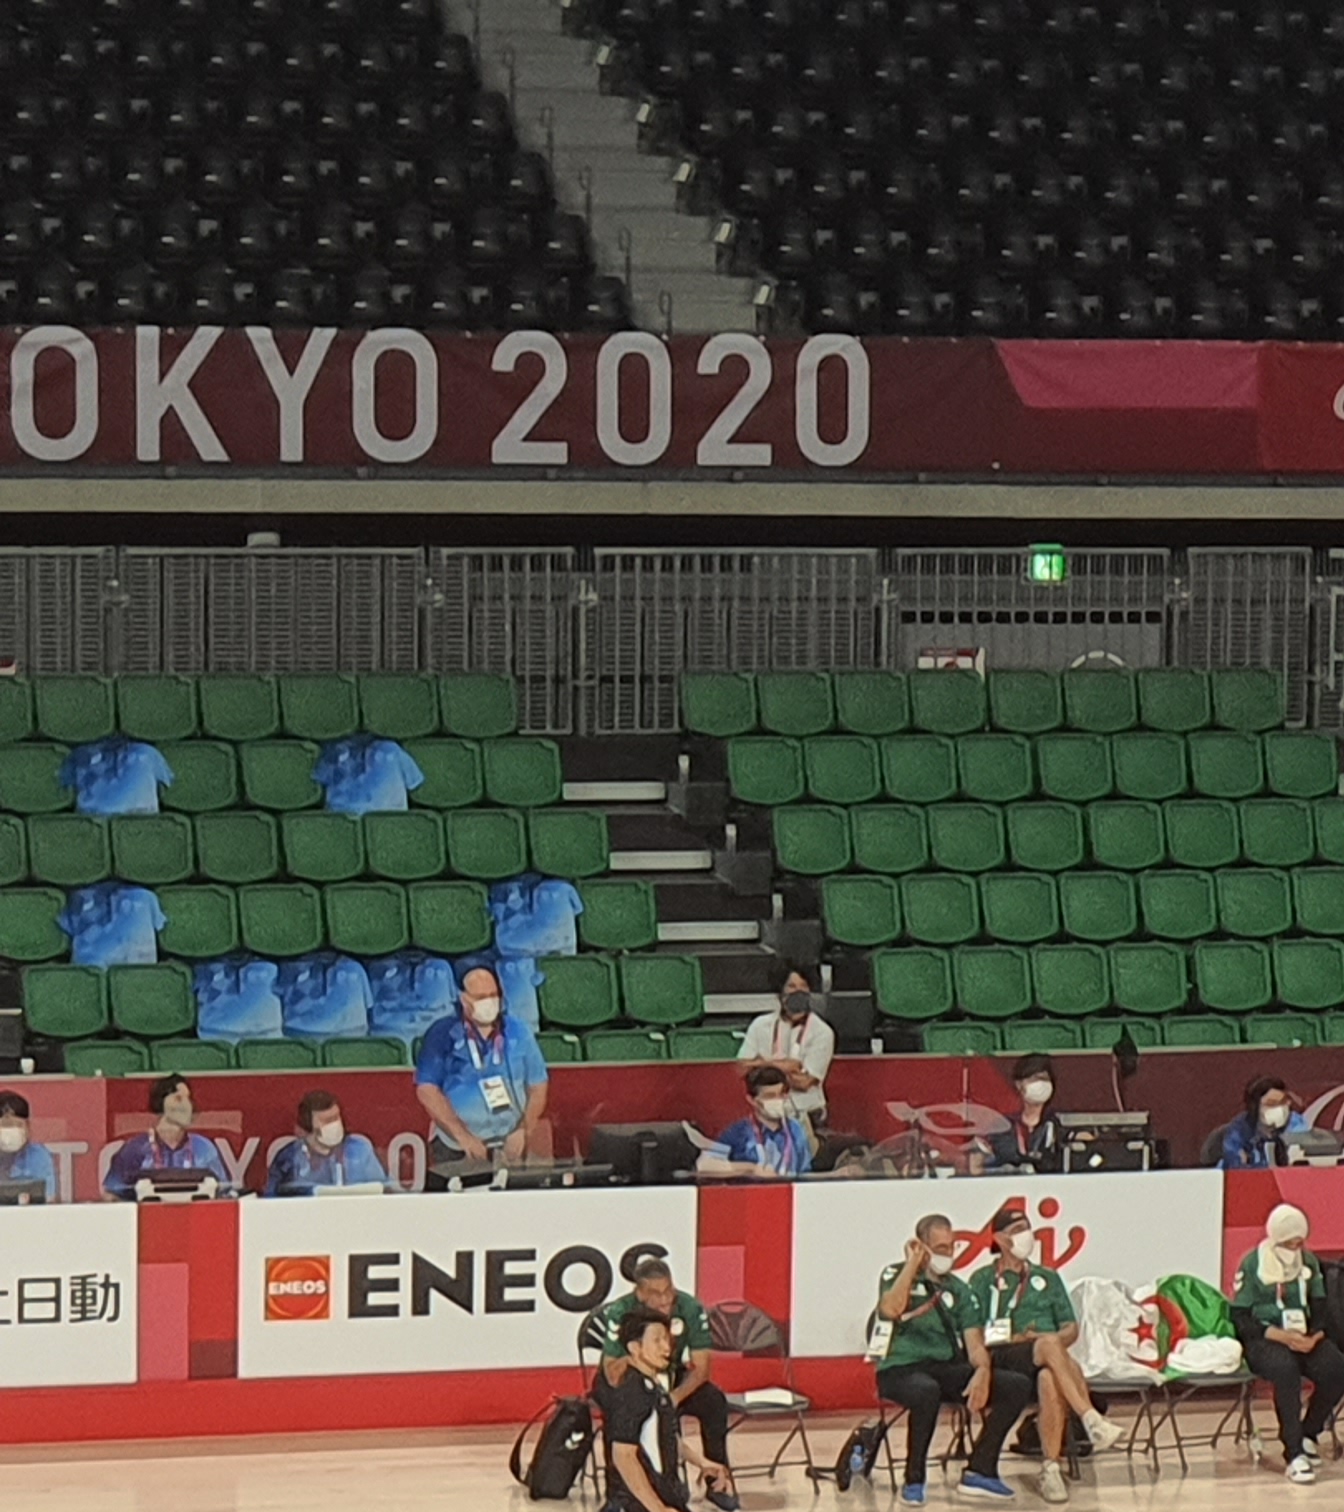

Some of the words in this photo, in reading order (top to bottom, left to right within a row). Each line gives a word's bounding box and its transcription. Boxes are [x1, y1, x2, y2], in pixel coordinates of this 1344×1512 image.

[490, 331, 872, 467] 2020
[0, 1272, 121, 1325] 日動
[267, 1279, 327, 1296] ENEOS
